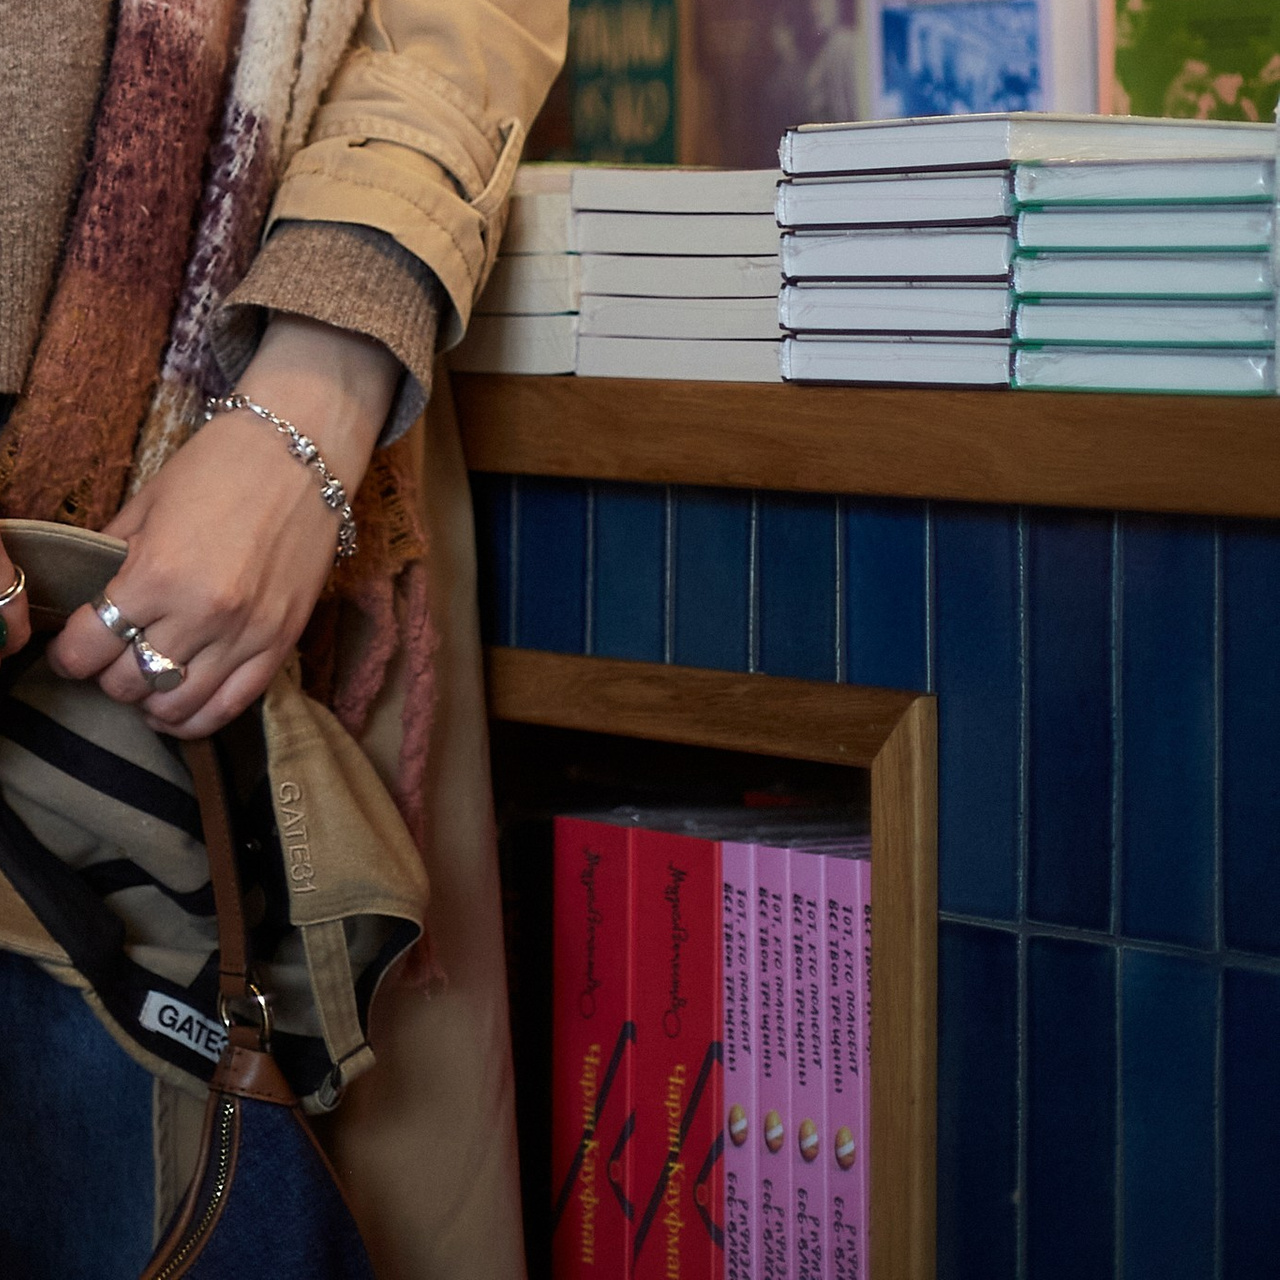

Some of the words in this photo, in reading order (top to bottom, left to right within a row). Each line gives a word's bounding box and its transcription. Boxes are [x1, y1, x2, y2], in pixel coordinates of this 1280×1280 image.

[279, 781, 318, 894] GATE31
[723, 883, 733, 914] ВСЕ
[758, 887, 768, 918] ВСЕ
[793, 893, 802, 926] ВСЕ
[828, 898, 839, 931] ВСЕ
[724, 922, 733, 968] ТВОИ
[738, 931, 747, 965] КТО
[759, 928, 768, 973] ТВОИ
[774, 937, 783, 970] КТО
[794, 934, 803, 980] ТВОИ
[808, 943, 817, 977] КТО
[829, 941, 839, 987] ТВОИ
[844, 950, 853, 984] КТО
[725, 976, 736, 1073] ТРЕЩИНЫ
[739, 971, 751, 1055] ПОЛЮБИТ
[760, 981, 772, 1078] ТРЕЩИНЫ
[775, 976, 787, 1061] ПОЛЮБИТ
[795, 988, 806, 1087] ТРЕЩИНЫ
[810, 984, 821, 1069] ПОЛЮБИТ
[829, 995, 842, 1094] ТРЕЩИНЫ
[846, 990, 858, 1077] ПОЛЮБИТ
[579, 1043, 601, 1131] Чарли
[665, 1064, 686, 1153] Чарли
[578, 1138, 600, 1265] Кауфман
